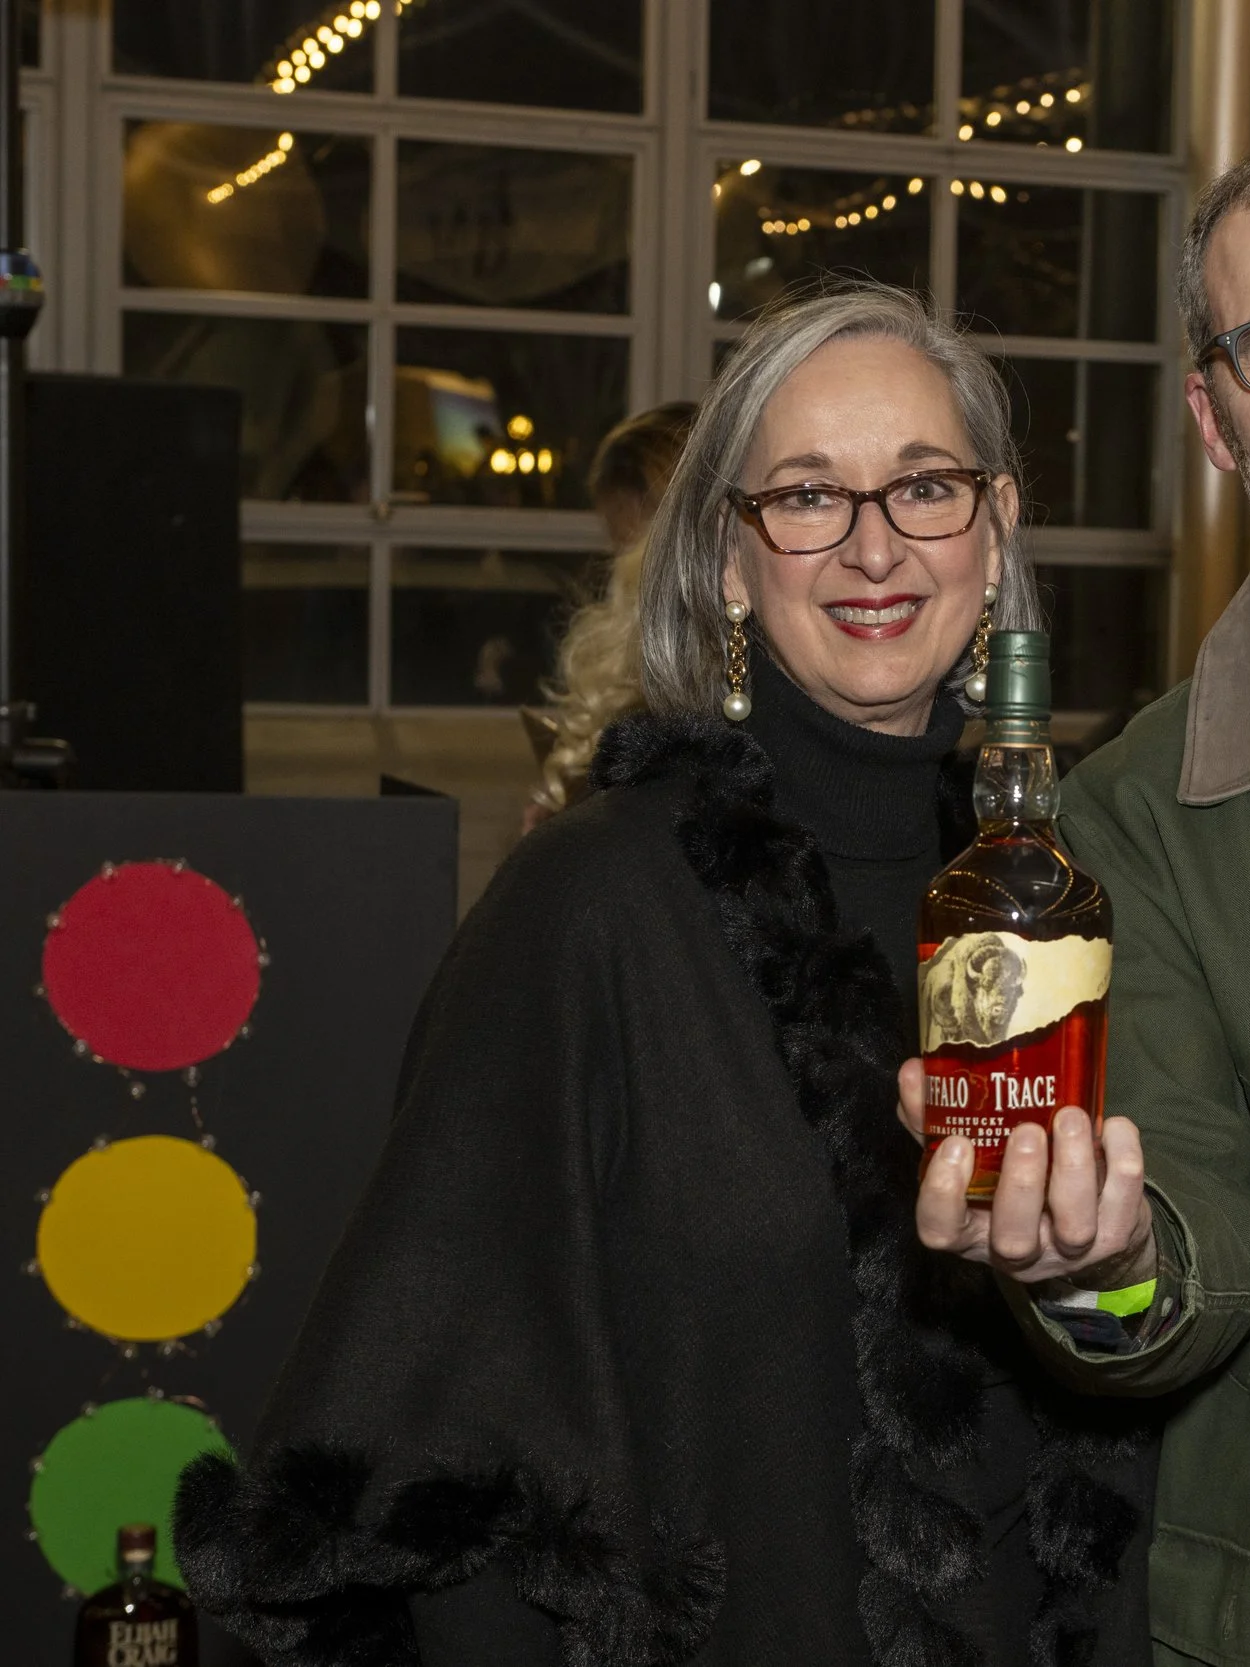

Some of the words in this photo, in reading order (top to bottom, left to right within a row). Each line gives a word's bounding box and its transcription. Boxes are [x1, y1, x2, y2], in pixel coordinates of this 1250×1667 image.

[926, 1075, 969, 1109] FFALO
[990, 1072, 1056, 1111] TRACE
[945, 1116, 1004, 1126] KENTUCKY
[977, 1127, 1011, 1136] BOUR
[970, 1138, 1000, 1147] SKEY
[107, 1641, 178, 1667] CRAIG
